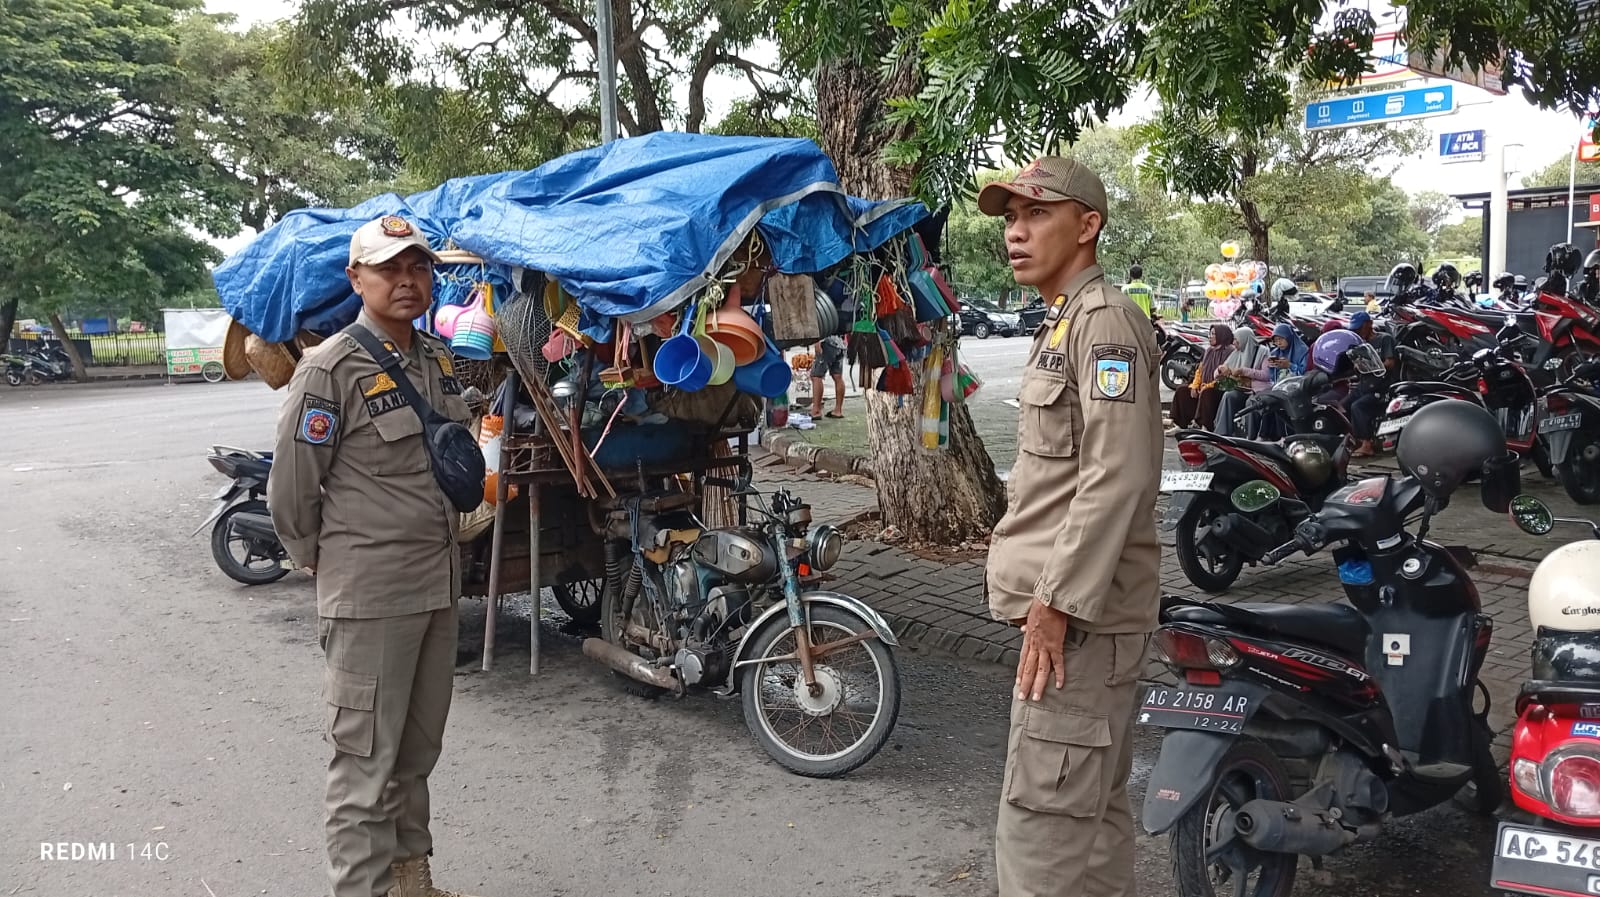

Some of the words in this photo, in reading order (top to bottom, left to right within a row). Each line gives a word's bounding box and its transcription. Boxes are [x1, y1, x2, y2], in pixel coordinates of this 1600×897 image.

[1456, 132, 1475, 142] ATM
[1146, 689, 1168, 706] AG
[1172, 691, 1215, 710] 2158
[1222, 695, 1248, 713] AR
[1506, 834, 1537, 859] AG
